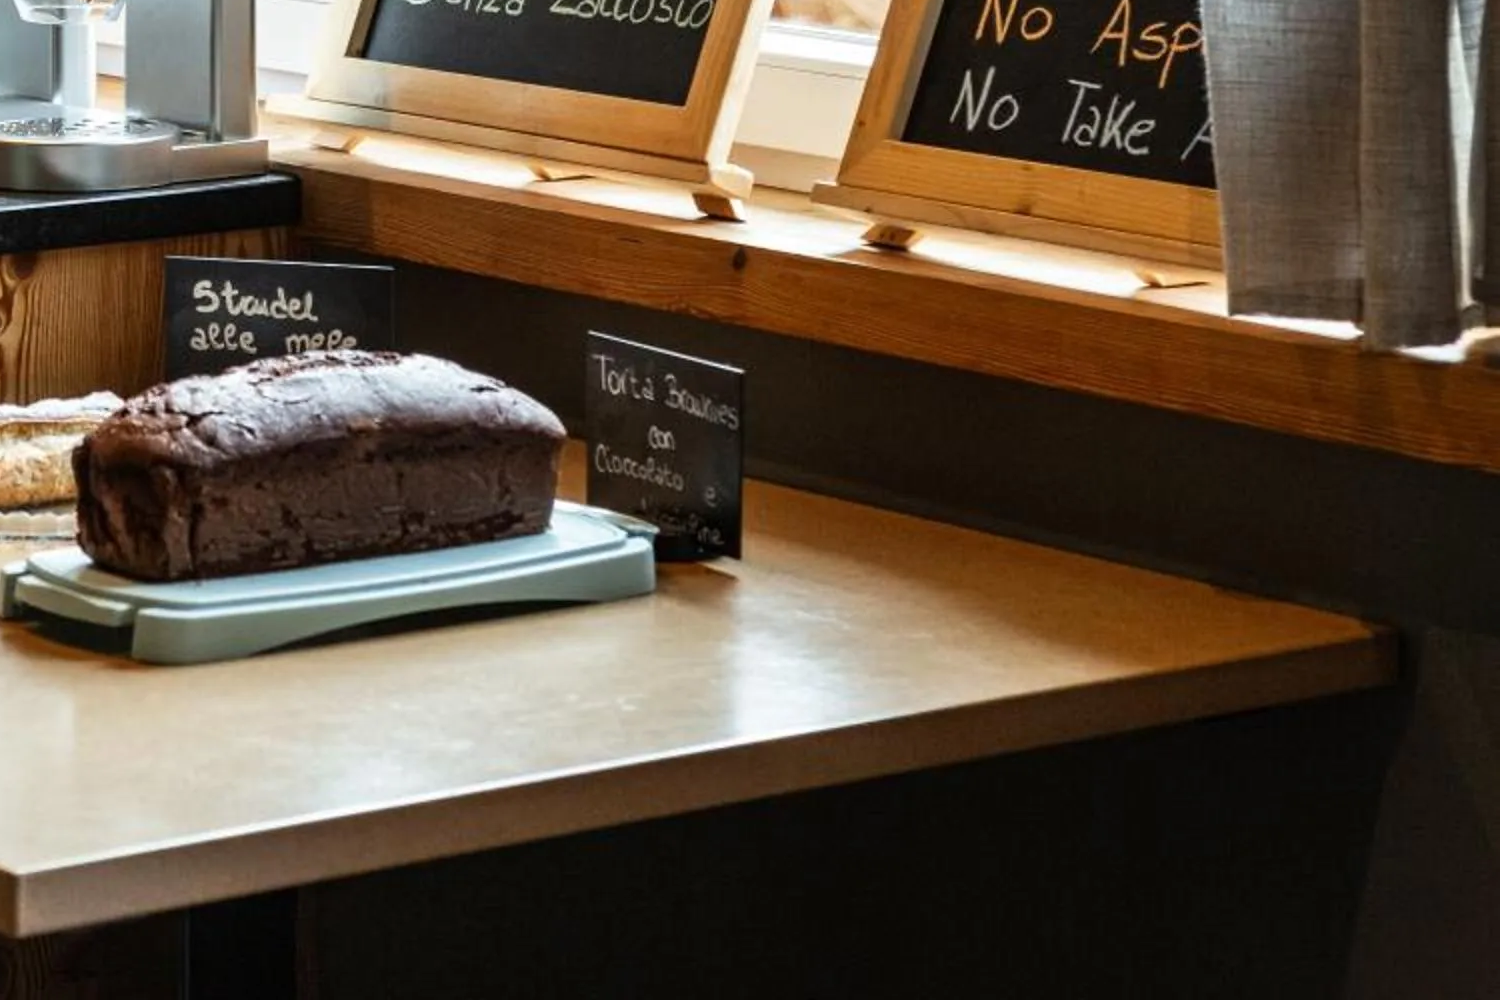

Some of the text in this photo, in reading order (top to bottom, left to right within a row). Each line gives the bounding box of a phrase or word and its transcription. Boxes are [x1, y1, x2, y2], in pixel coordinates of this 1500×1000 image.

[949, 65, 1019, 132] No
[190, 322, 257, 354] alle
[591, 353, 655, 401] Torta
[648, 425, 676, 451] con
[595, 444, 684, 491] Cioccolato
